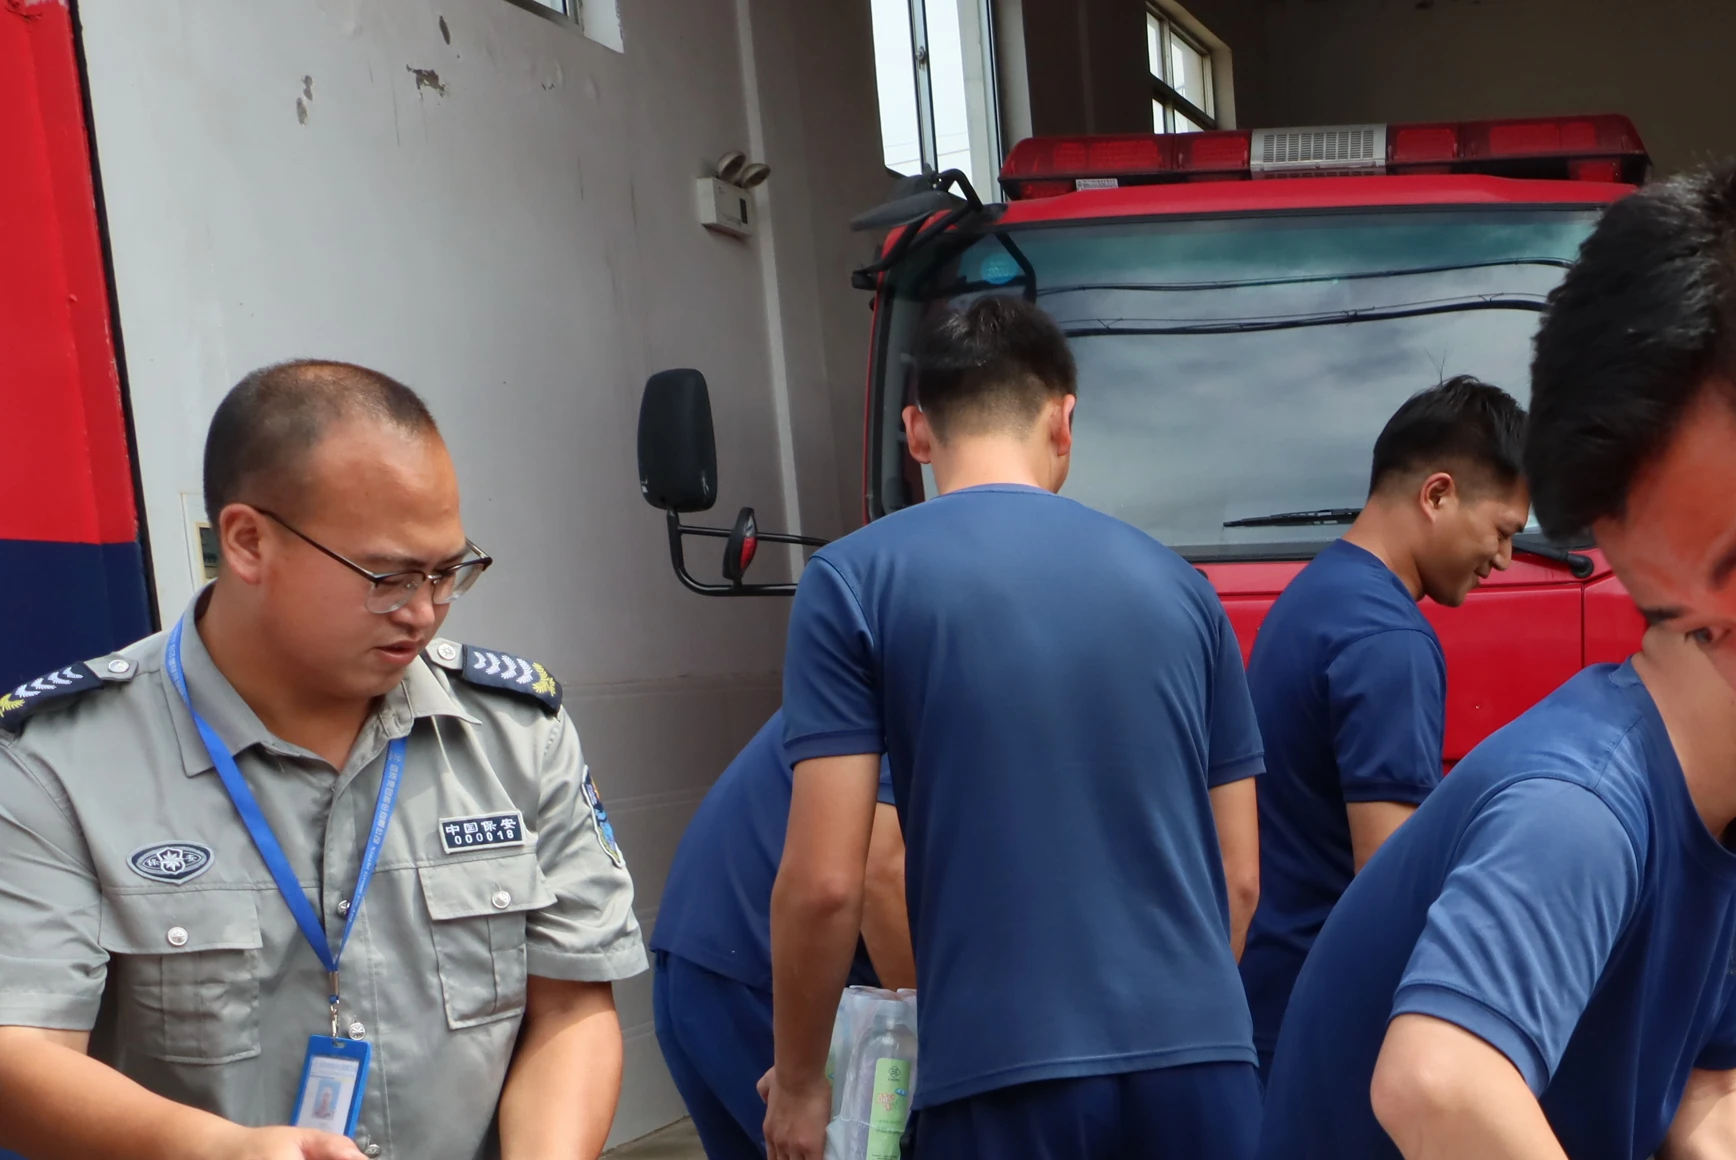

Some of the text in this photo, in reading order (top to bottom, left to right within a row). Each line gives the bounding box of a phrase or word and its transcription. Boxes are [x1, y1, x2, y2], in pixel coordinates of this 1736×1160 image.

[445, 818, 517, 836] 中国保安
[454, 829, 514, 845] 000018
